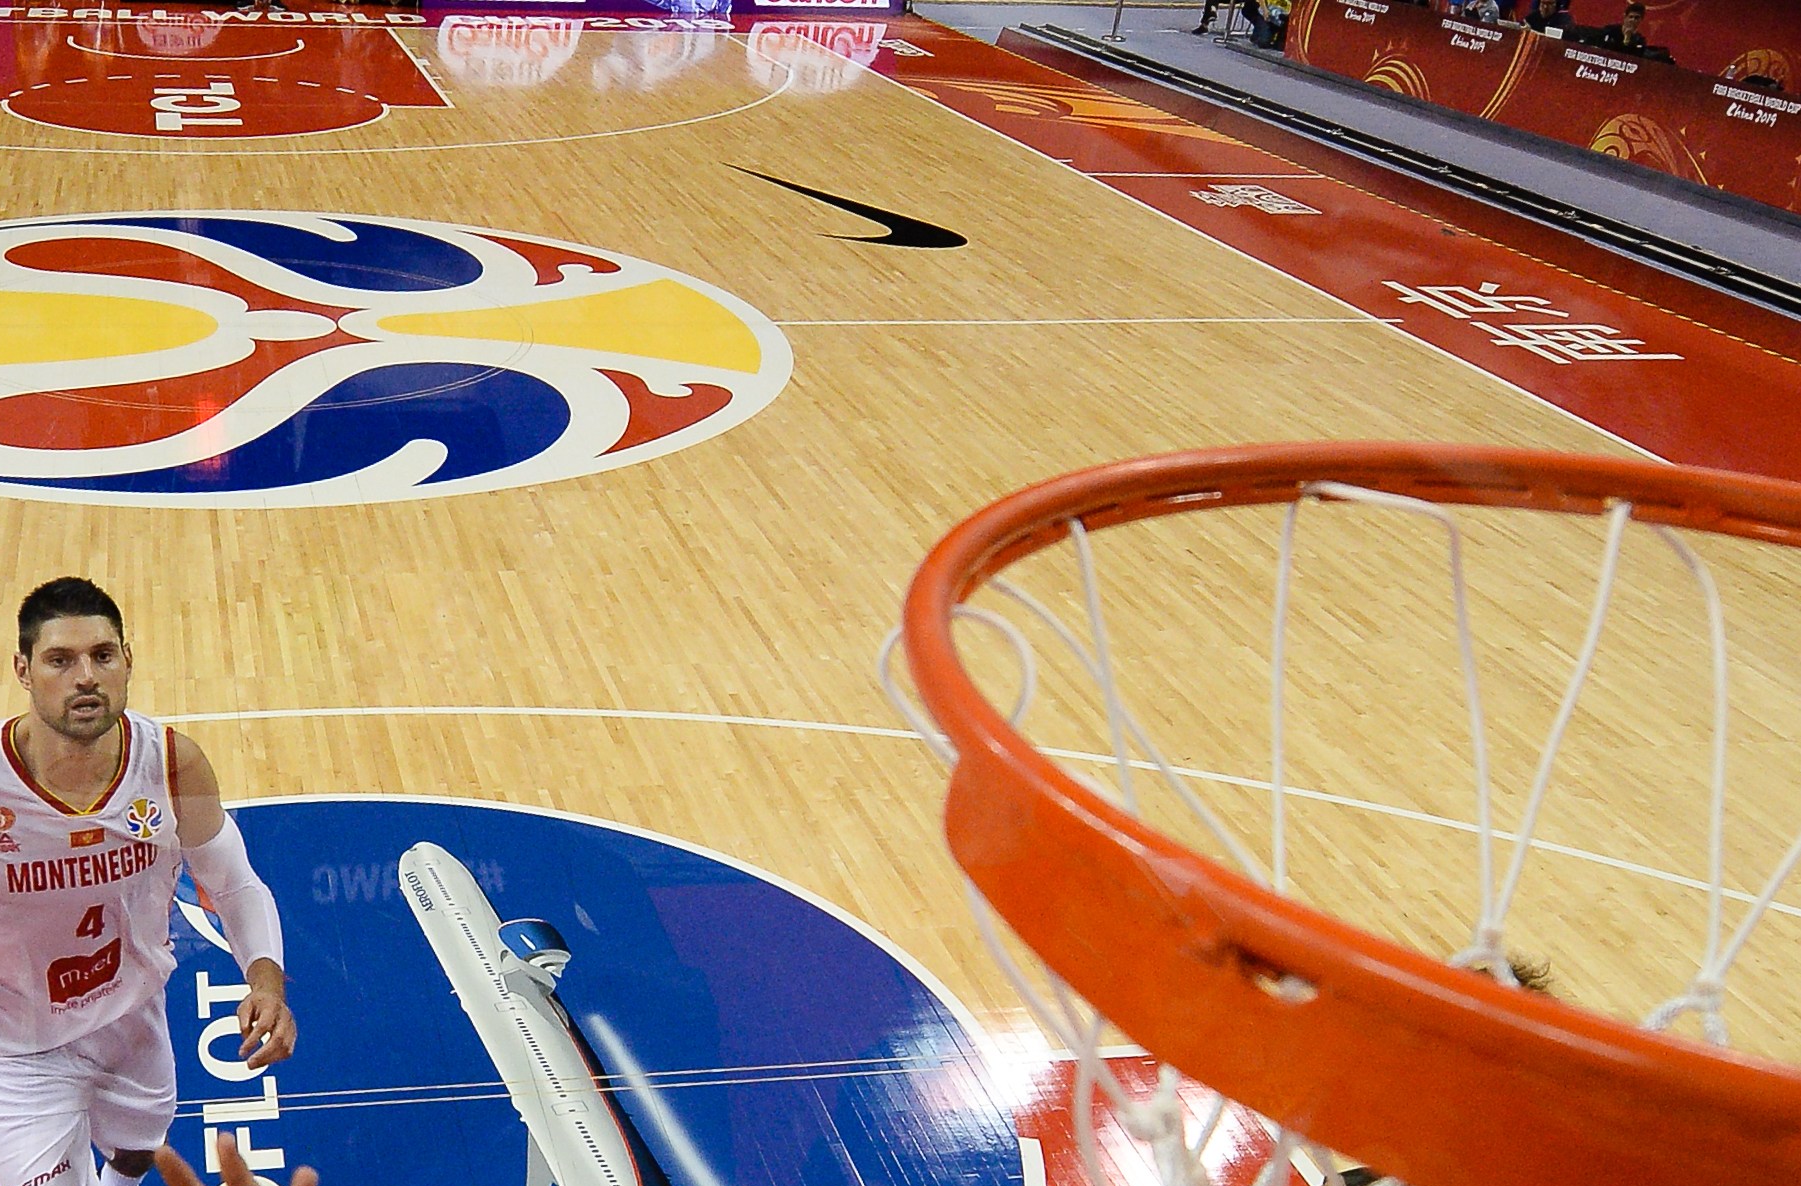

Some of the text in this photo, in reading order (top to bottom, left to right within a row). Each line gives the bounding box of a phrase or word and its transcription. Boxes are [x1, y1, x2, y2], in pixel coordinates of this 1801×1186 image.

[200, 10, 427, 24] WORLD
[582, 17, 736, 30] 2019
[150, 82, 243, 131] TCL
[1726, 102, 1778, 128] China 2019
[6, 842, 159, 894] MONTENEGRO
[404, 871, 436, 913] AEROFLOT
[76, 904, 105, 939] 4
